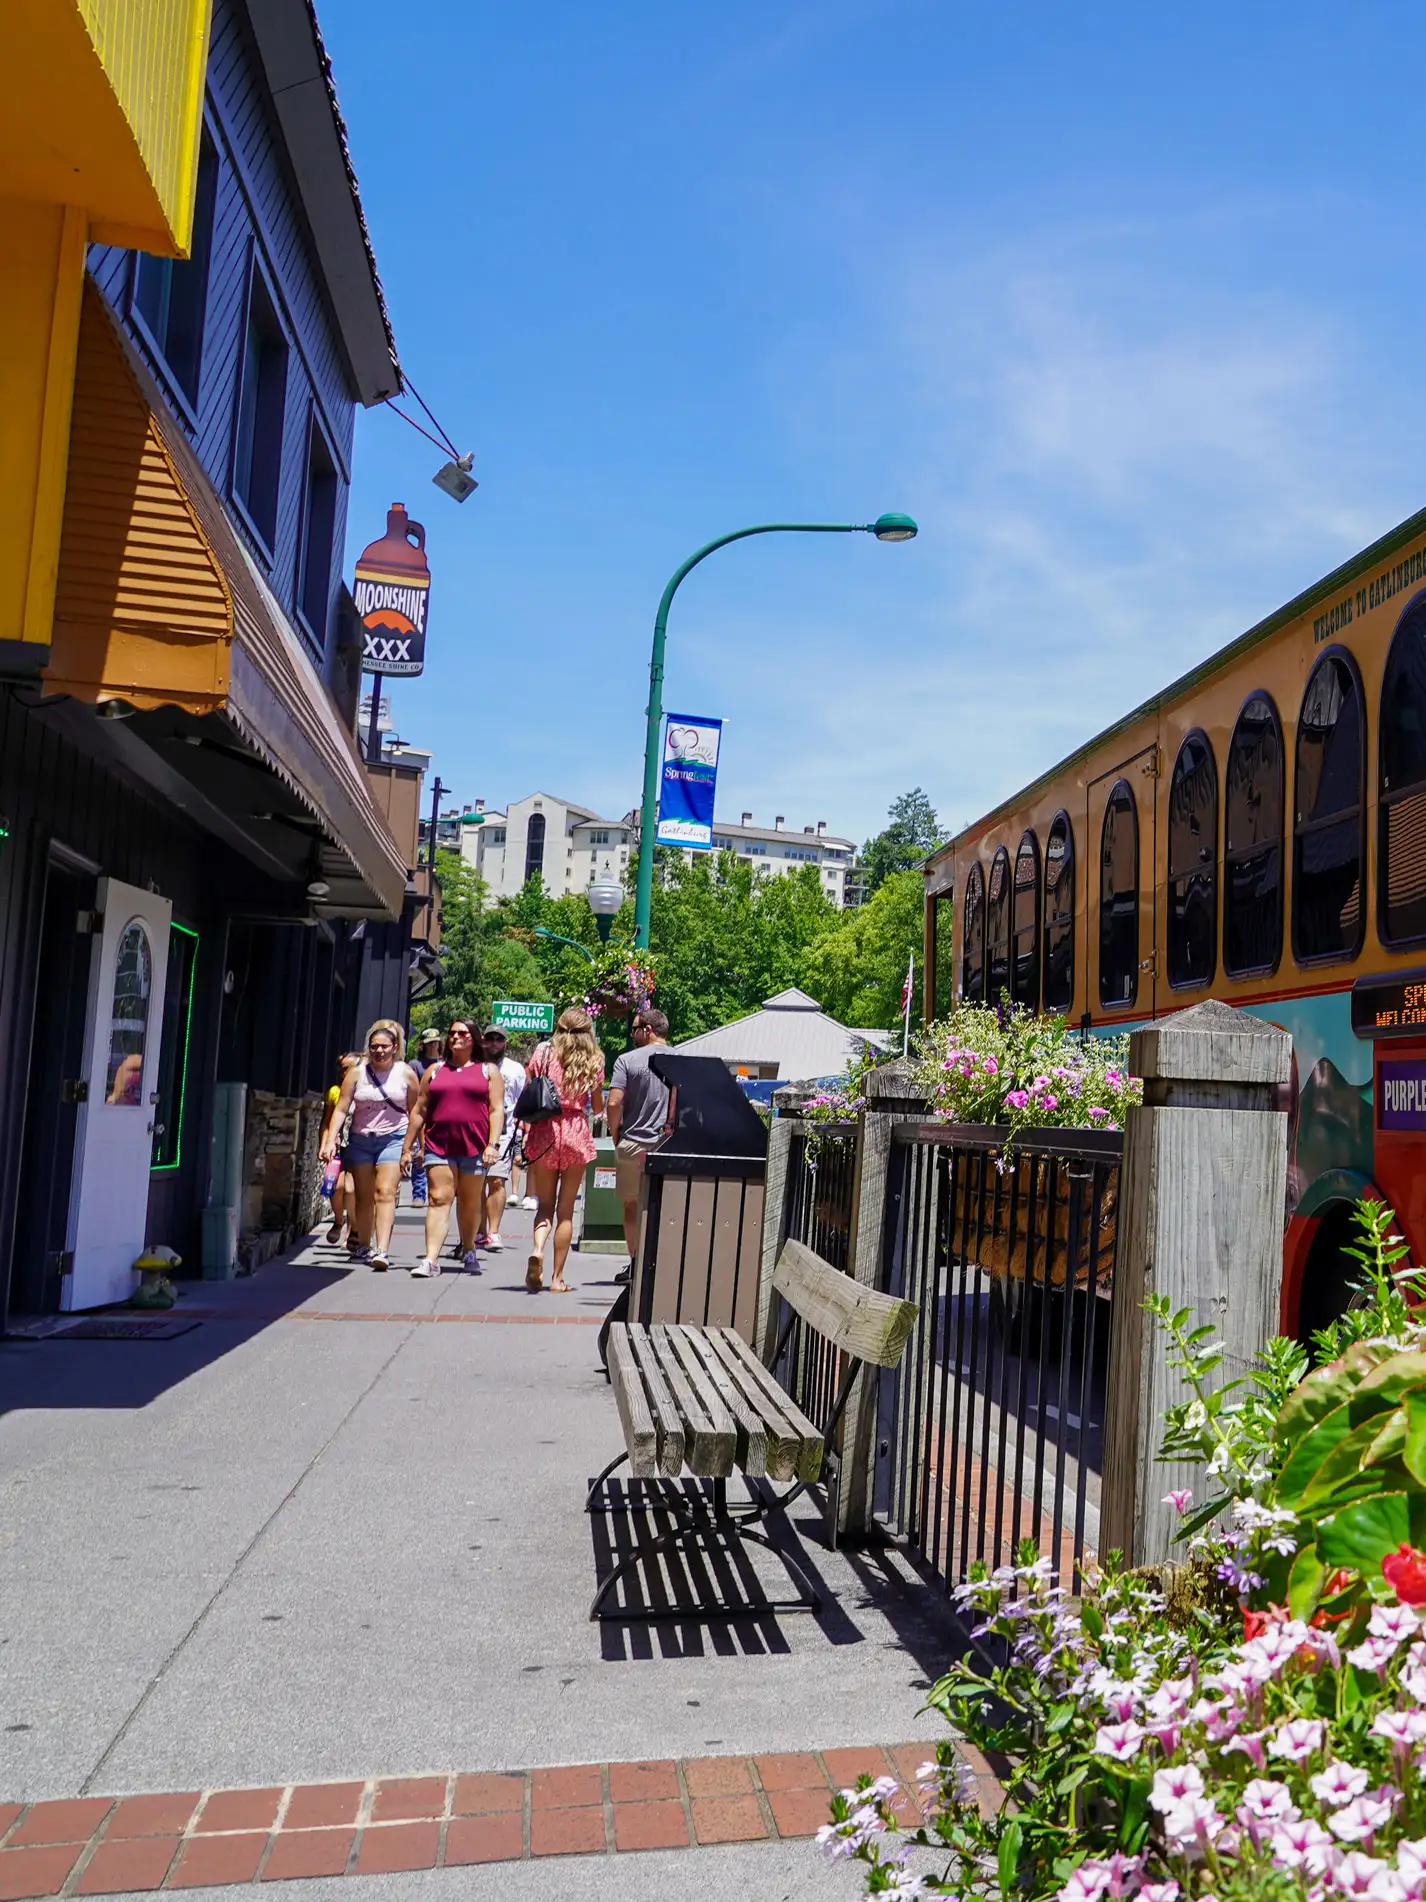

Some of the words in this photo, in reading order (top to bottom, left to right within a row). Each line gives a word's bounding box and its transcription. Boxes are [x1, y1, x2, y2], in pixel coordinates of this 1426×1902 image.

[354, 581, 427, 635] MOONSHINE
[1313, 597, 1353, 645] WELCOME
[1356, 588, 1367, 618] TO
[362, 633, 412, 661] XXX
[496, 1016, 549, 1029] PARKING
[501, 1005, 545, 1017] PUBLIC
